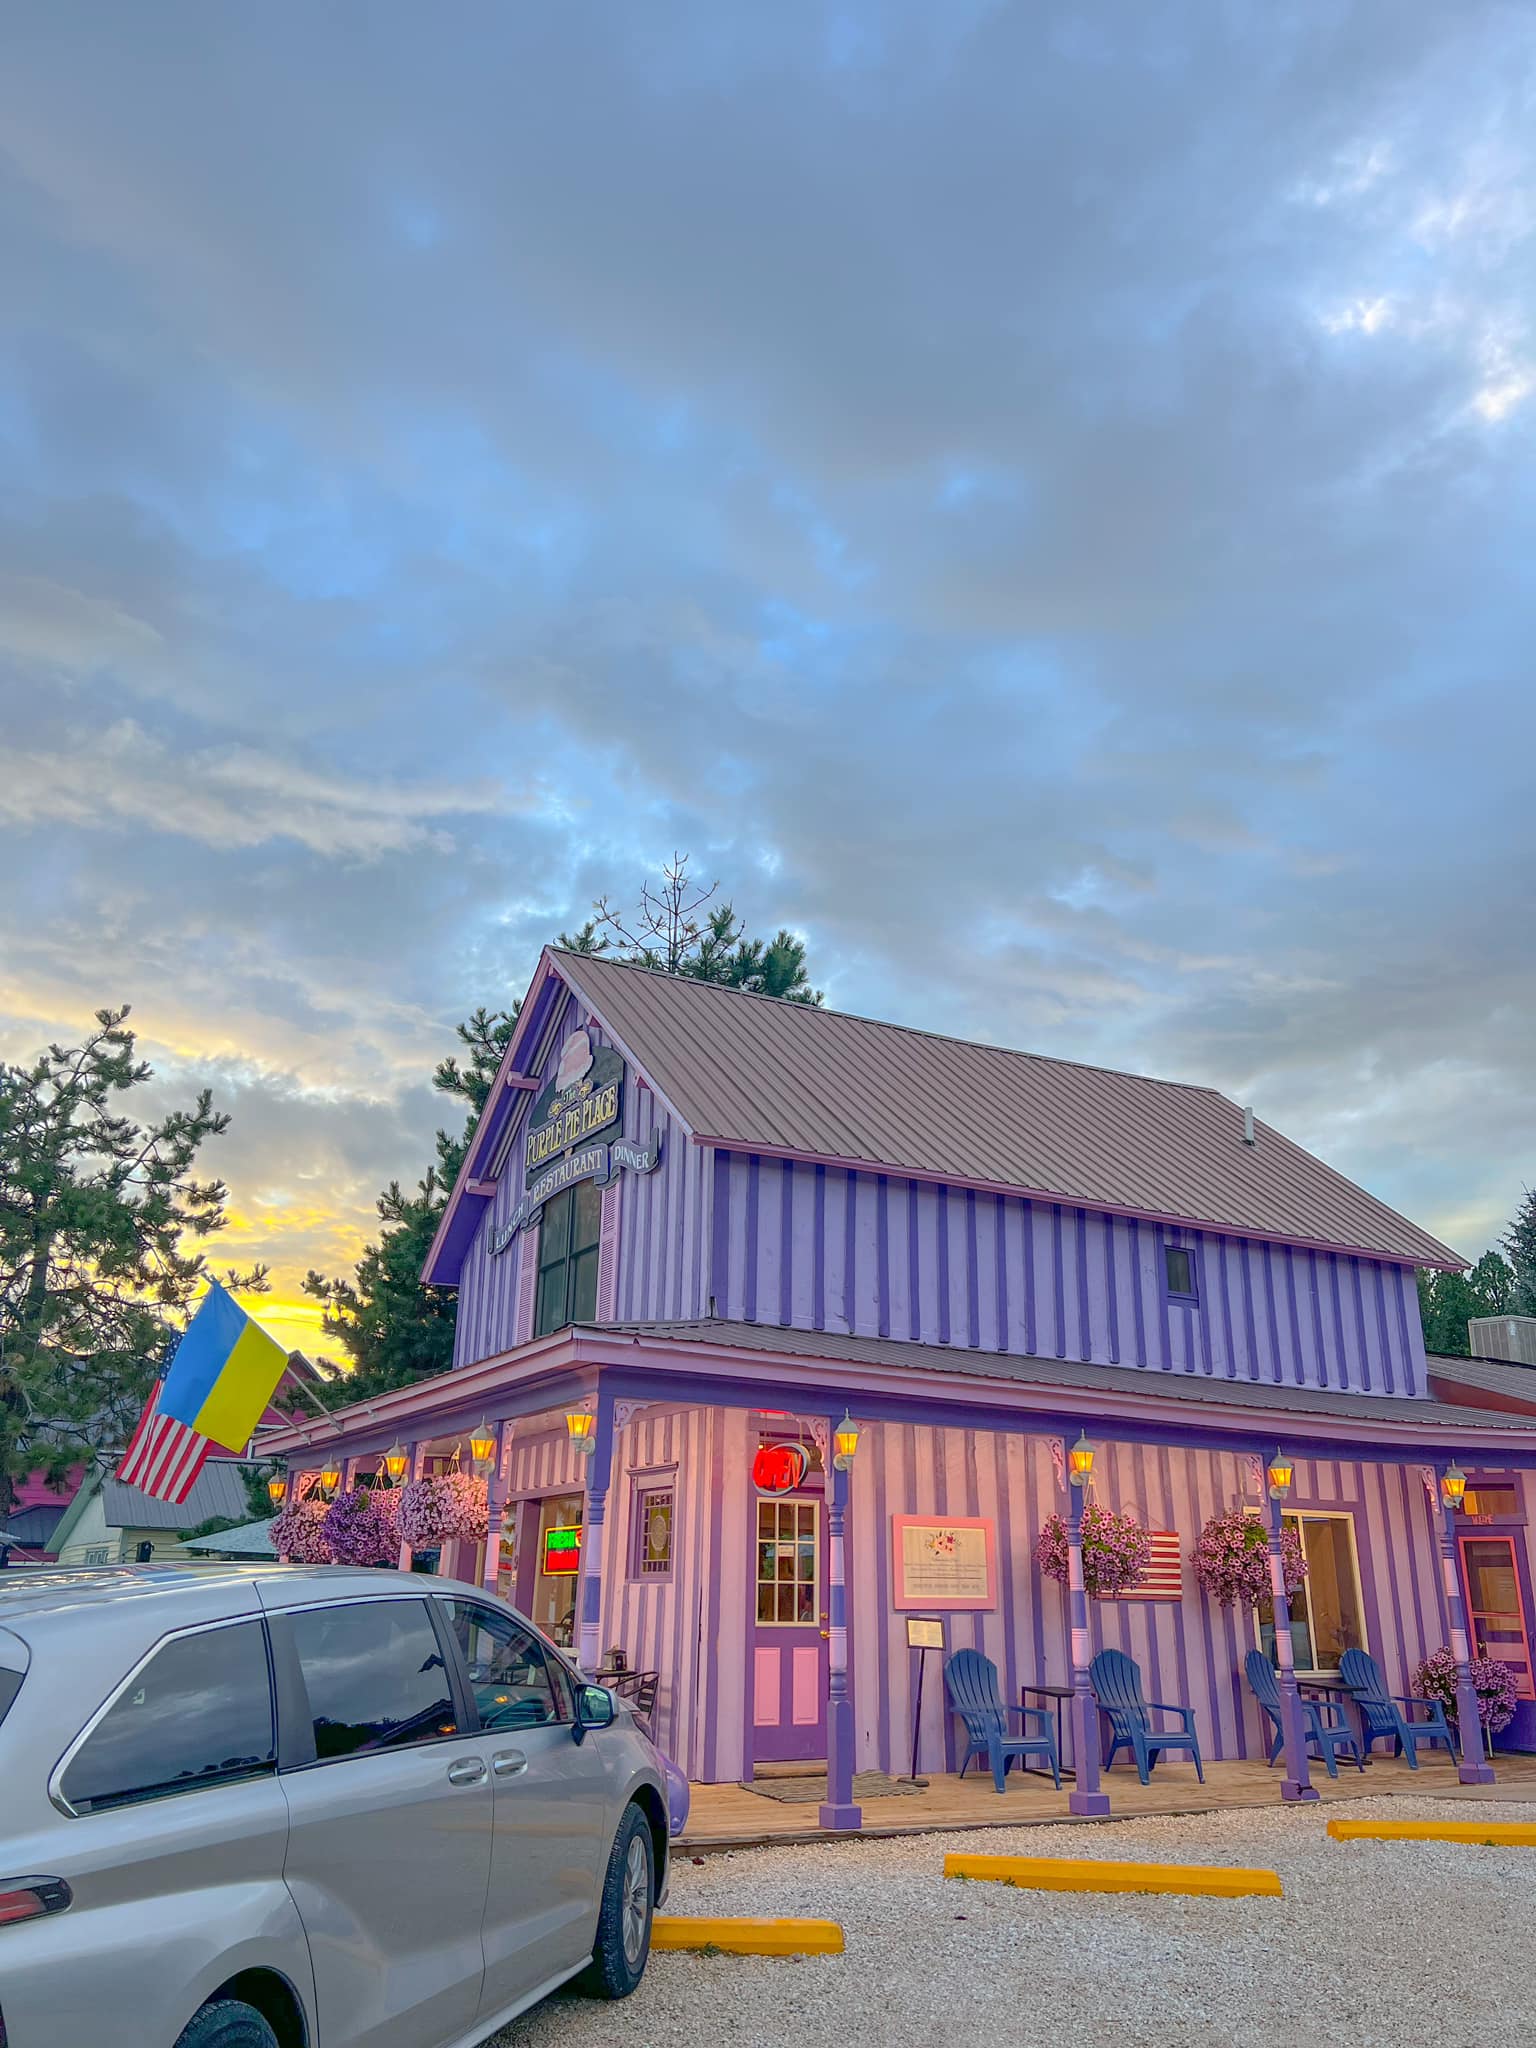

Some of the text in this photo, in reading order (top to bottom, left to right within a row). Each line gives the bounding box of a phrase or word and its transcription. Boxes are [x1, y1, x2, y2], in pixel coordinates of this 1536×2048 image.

[526, 1086, 616, 1166] PURPLE PIE PLACE
[533, 1149, 603, 1204] RESTAURANT
[615, 1146, 649, 1169] DINNER
[495, 1203, 524, 1249] LUNCH
[753, 1450, 801, 1488] OPEN
